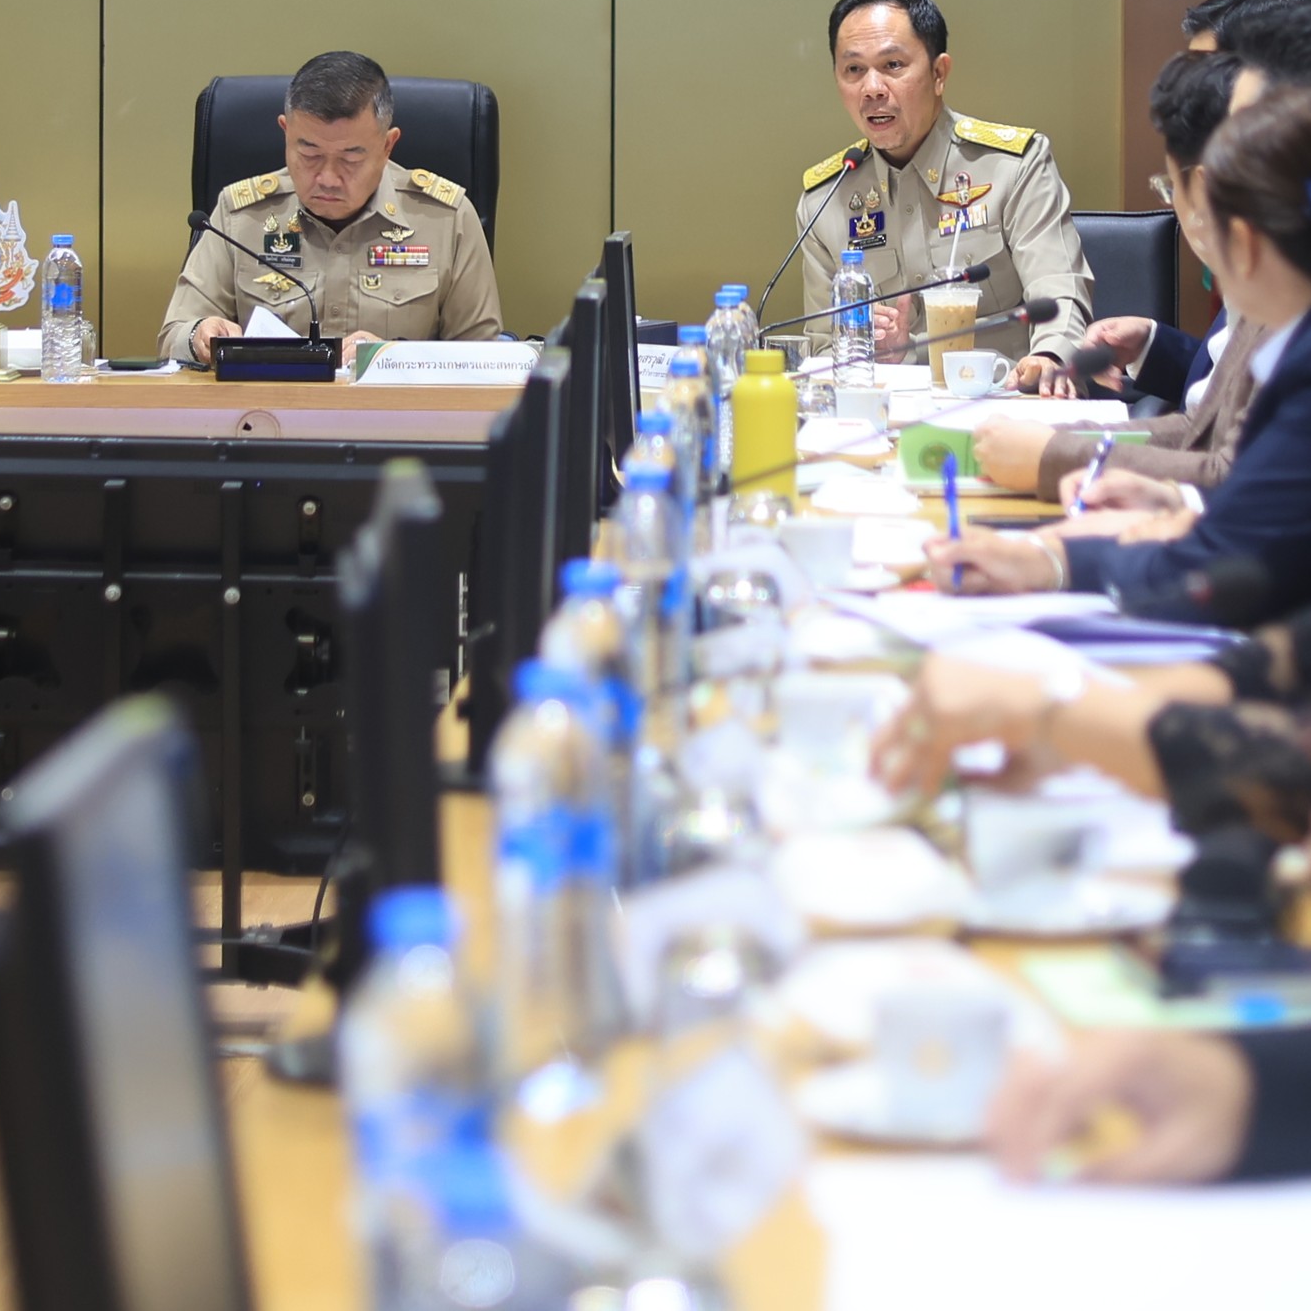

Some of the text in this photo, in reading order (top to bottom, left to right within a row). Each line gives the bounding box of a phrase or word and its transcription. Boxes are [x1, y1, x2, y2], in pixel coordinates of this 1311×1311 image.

[376, 358, 534, 370] ปลัดกระทรวงเกษตรและสหกรณ์
